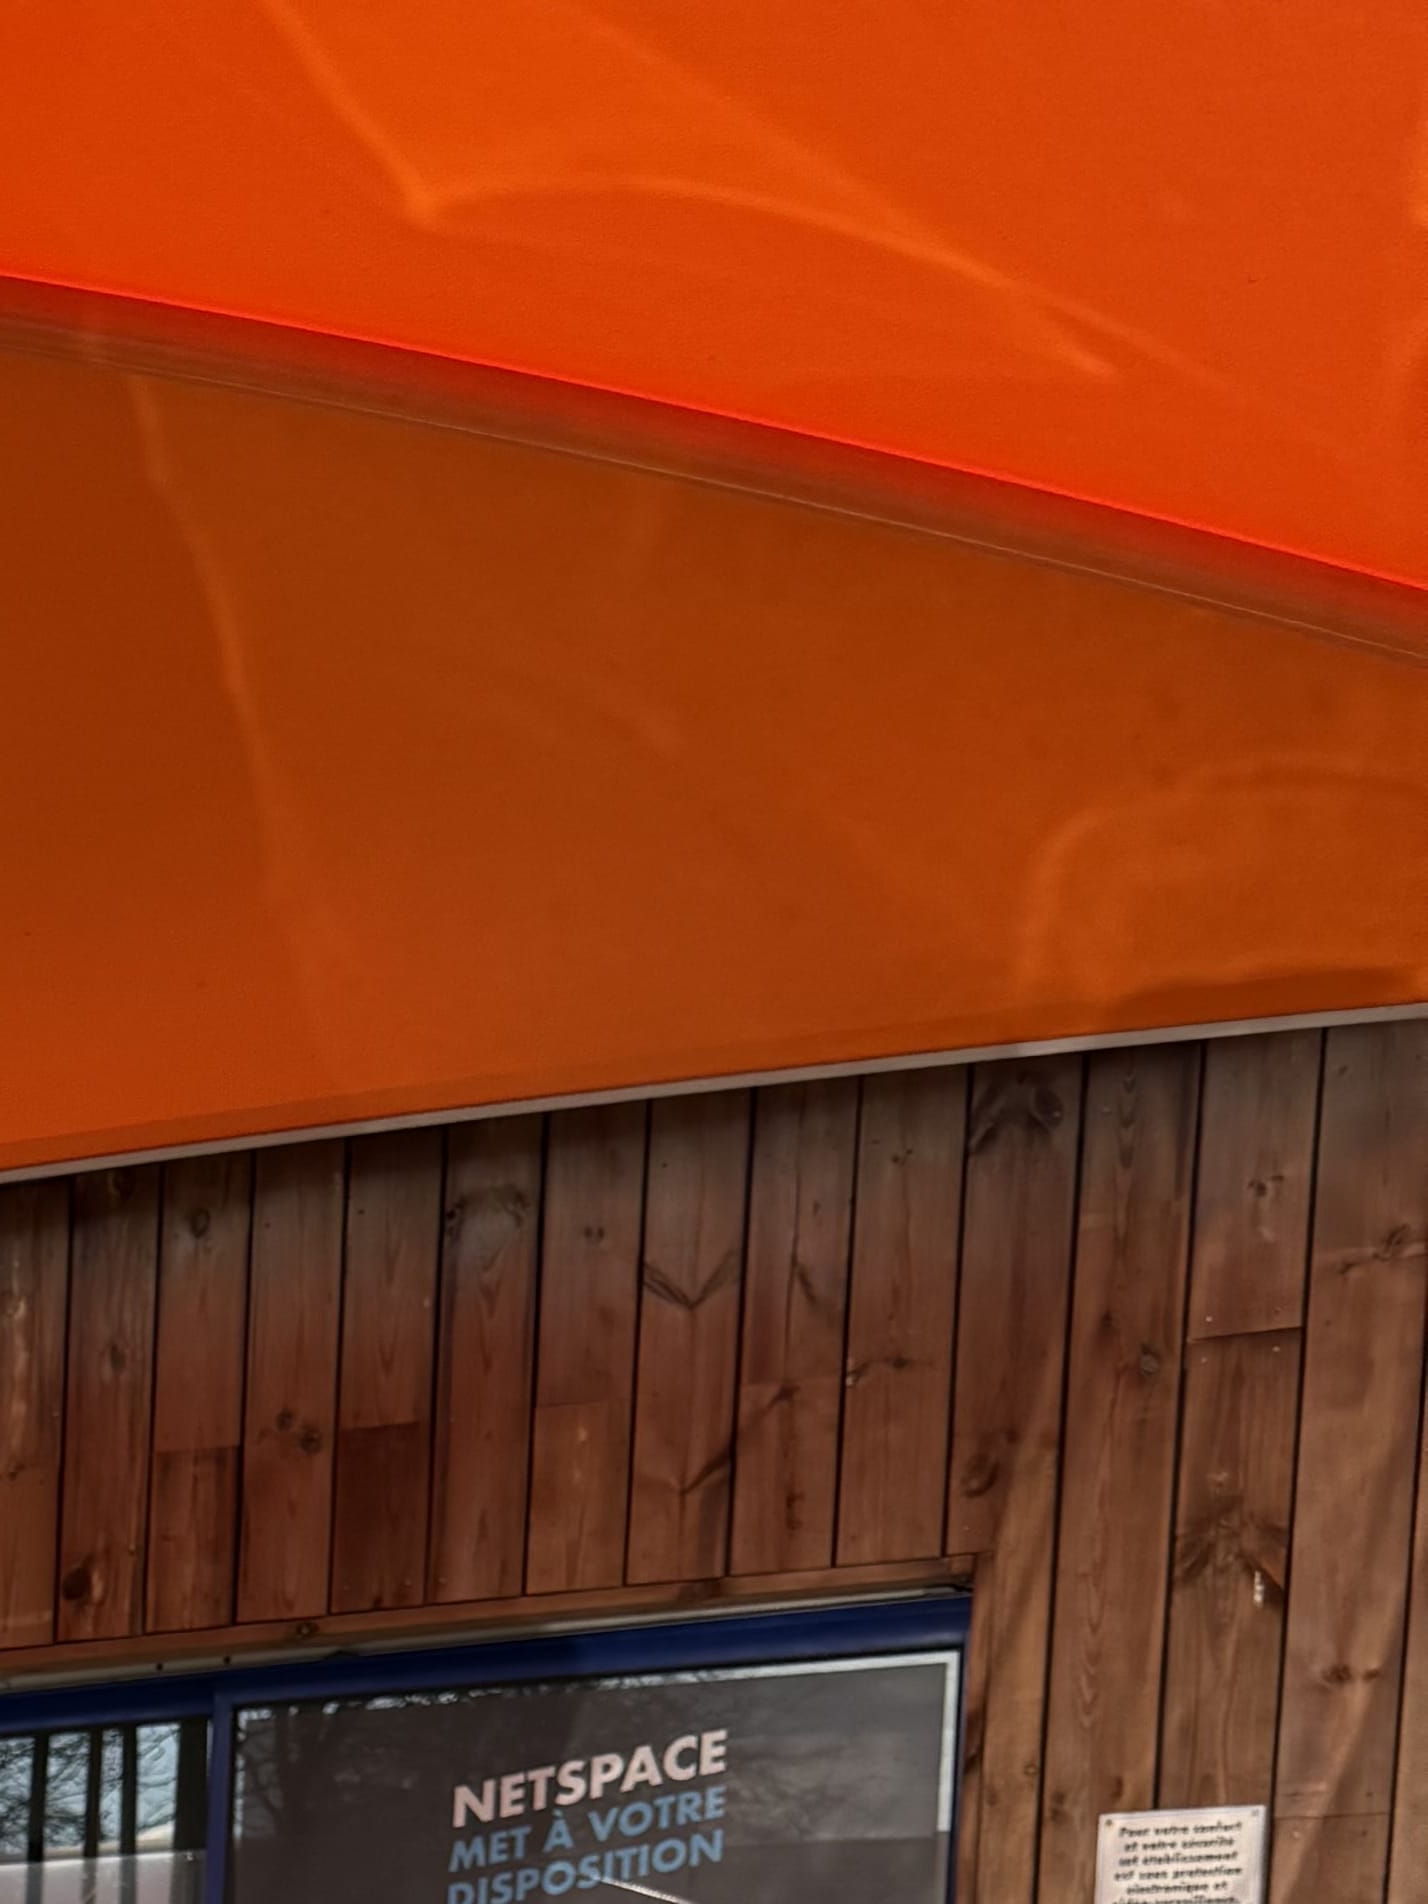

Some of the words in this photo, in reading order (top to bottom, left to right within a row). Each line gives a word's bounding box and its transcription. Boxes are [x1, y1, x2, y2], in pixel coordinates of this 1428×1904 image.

[453, 1729, 728, 1828] NETSPACE
[448, 1826, 532, 1872] MET
[545, 1809, 574, 1851] À
[588, 1785, 727, 1842] VOTRE
